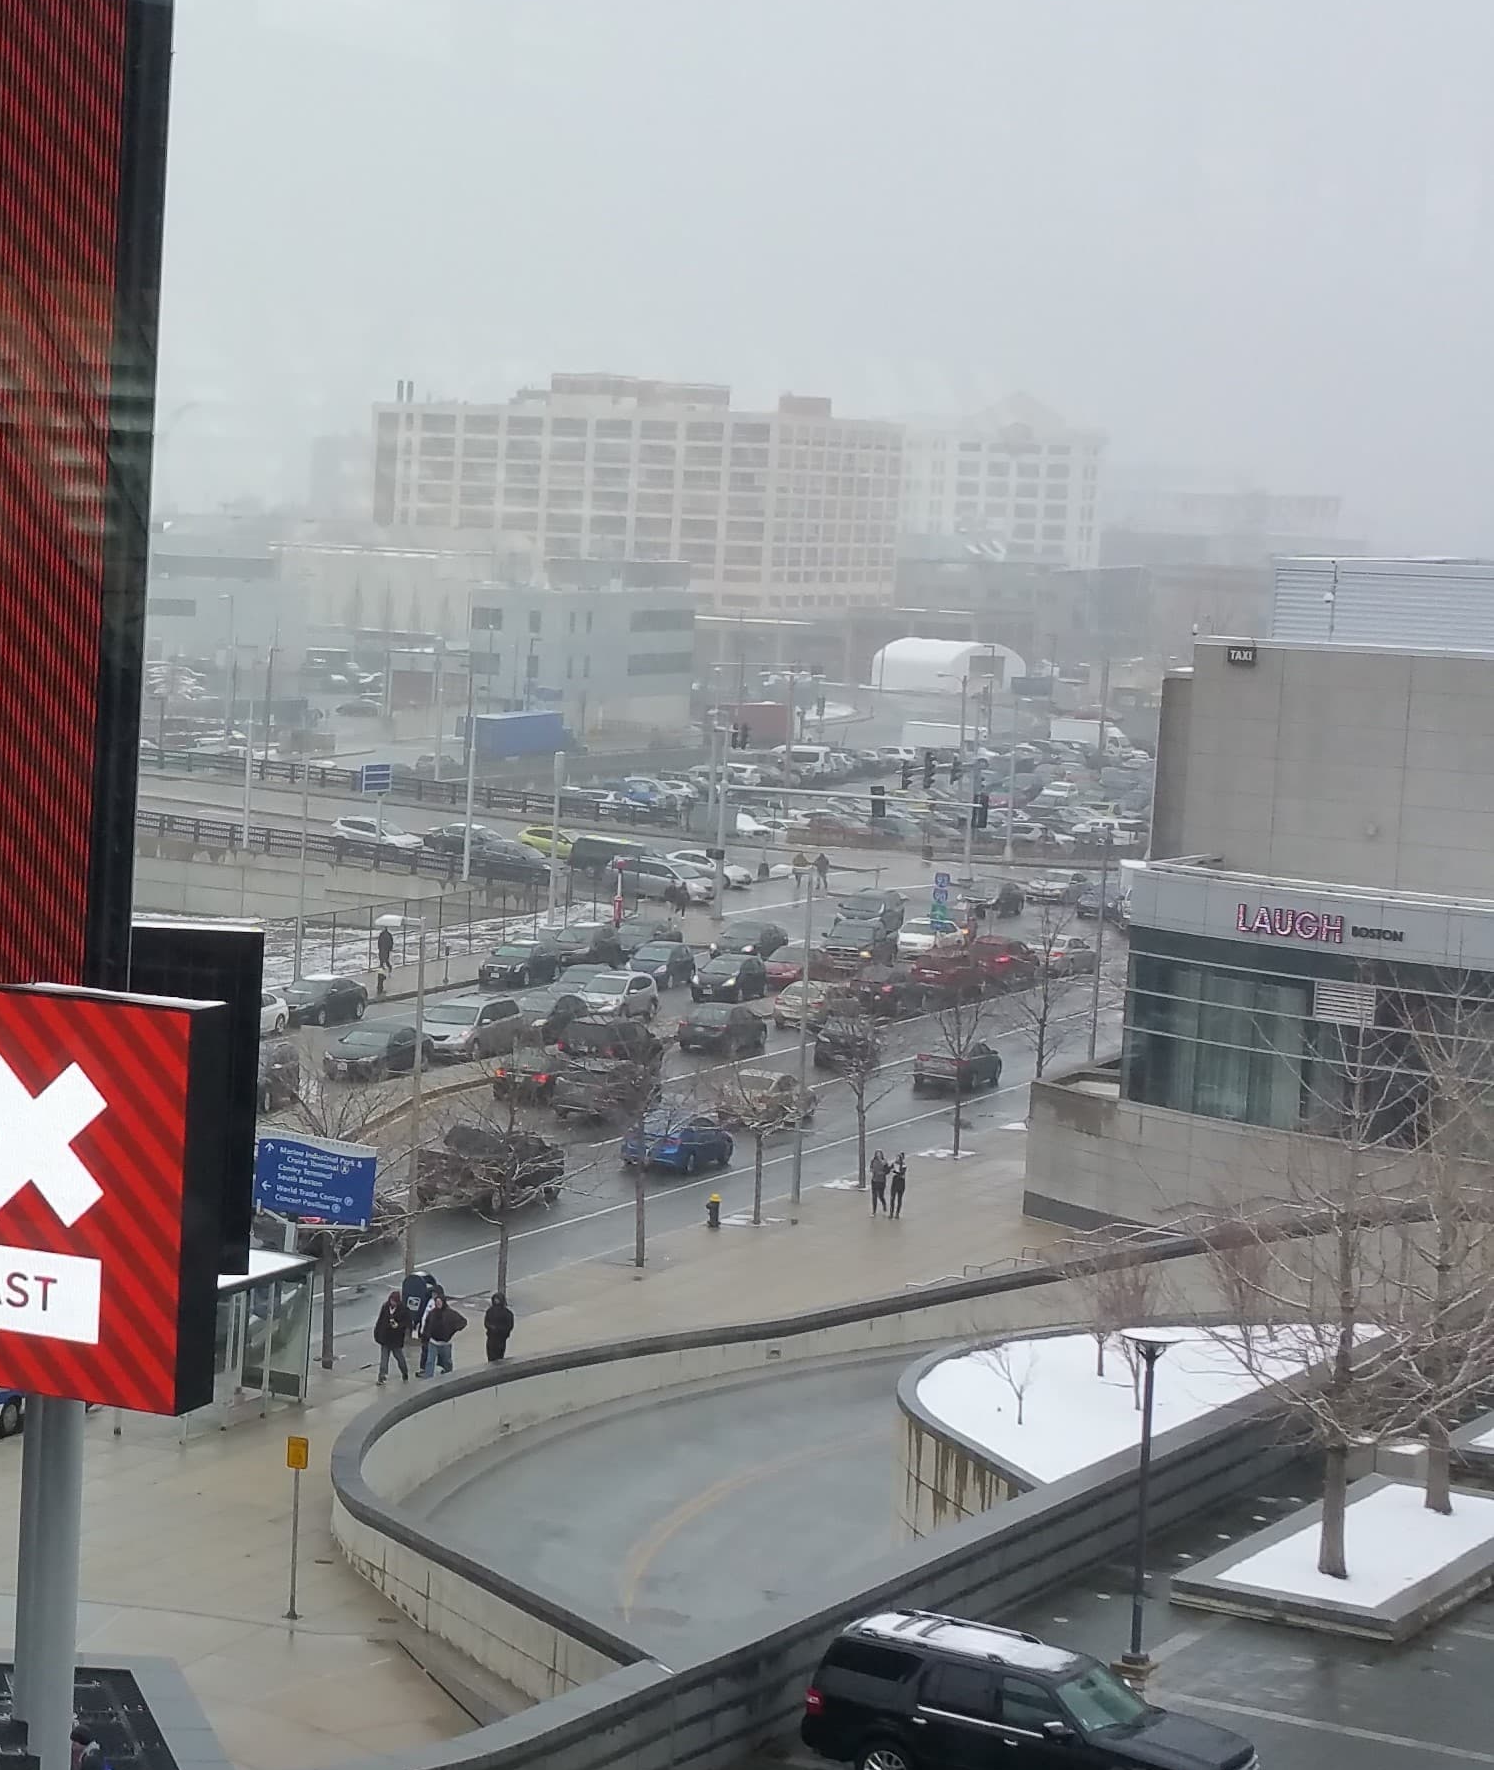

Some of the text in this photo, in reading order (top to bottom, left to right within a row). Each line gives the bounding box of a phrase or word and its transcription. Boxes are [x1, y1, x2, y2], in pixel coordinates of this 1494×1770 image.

[1230, 649, 1253, 662] TAXI
[1236, 903, 1404, 944] LAUGH BOSTON
